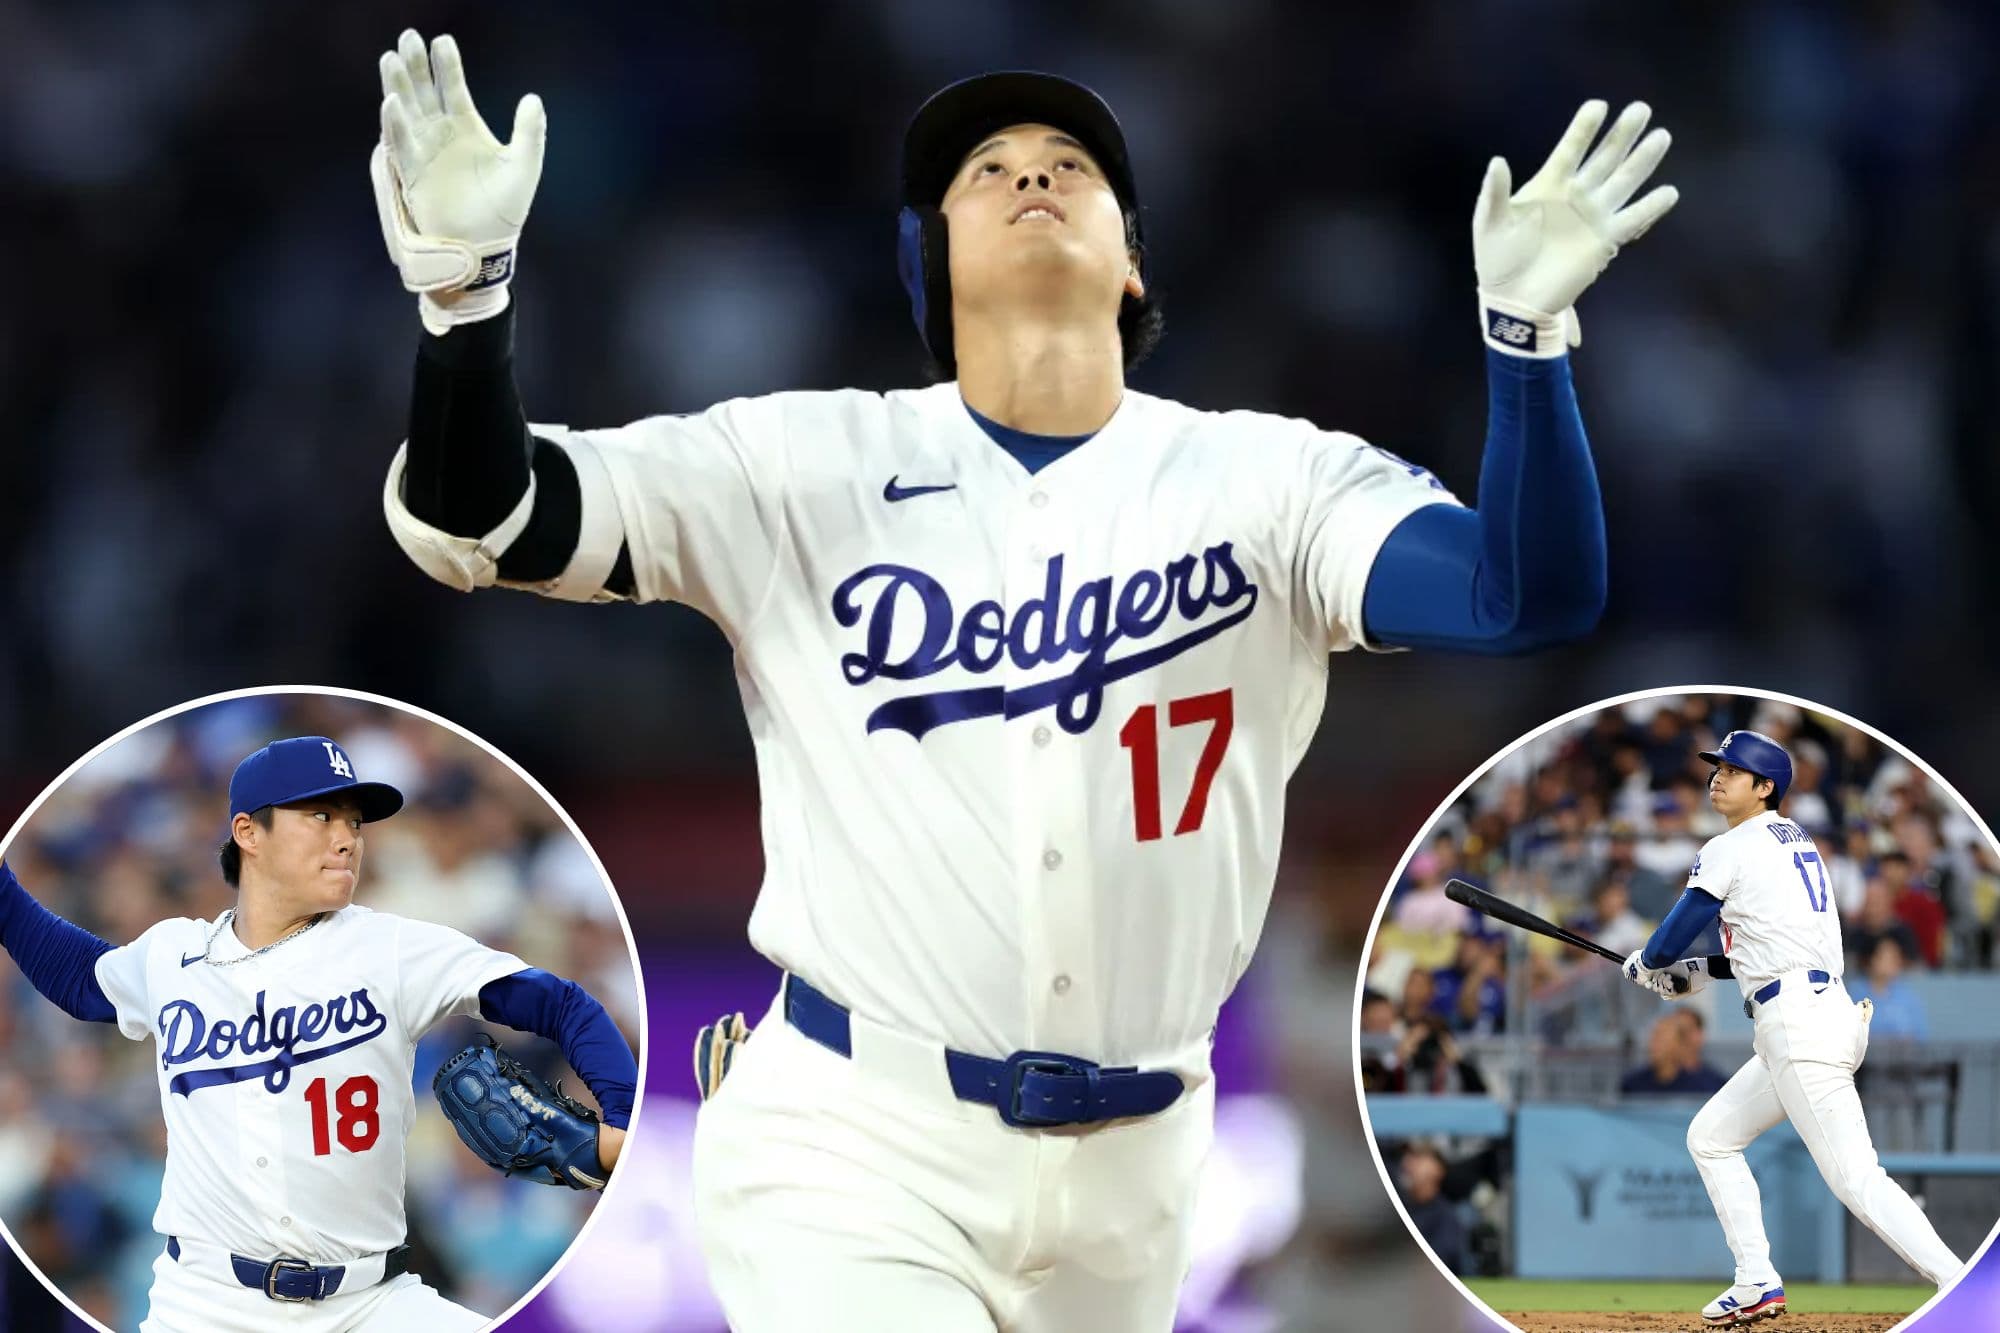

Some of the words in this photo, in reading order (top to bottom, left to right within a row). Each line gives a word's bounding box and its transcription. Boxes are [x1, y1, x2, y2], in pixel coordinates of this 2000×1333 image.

[1491, 316, 1533, 344] NB
[831, 541, 1258, 735] Dodgers
[322, 742, 353, 779] LA
[1119, 688, 1234, 842] 17
[1793, 851, 1827, 912] 17
[158, 988, 387, 1094] Dodgers
[304, 1075, 380, 1156] 18
[1718, 1296, 1740, 1311] N
